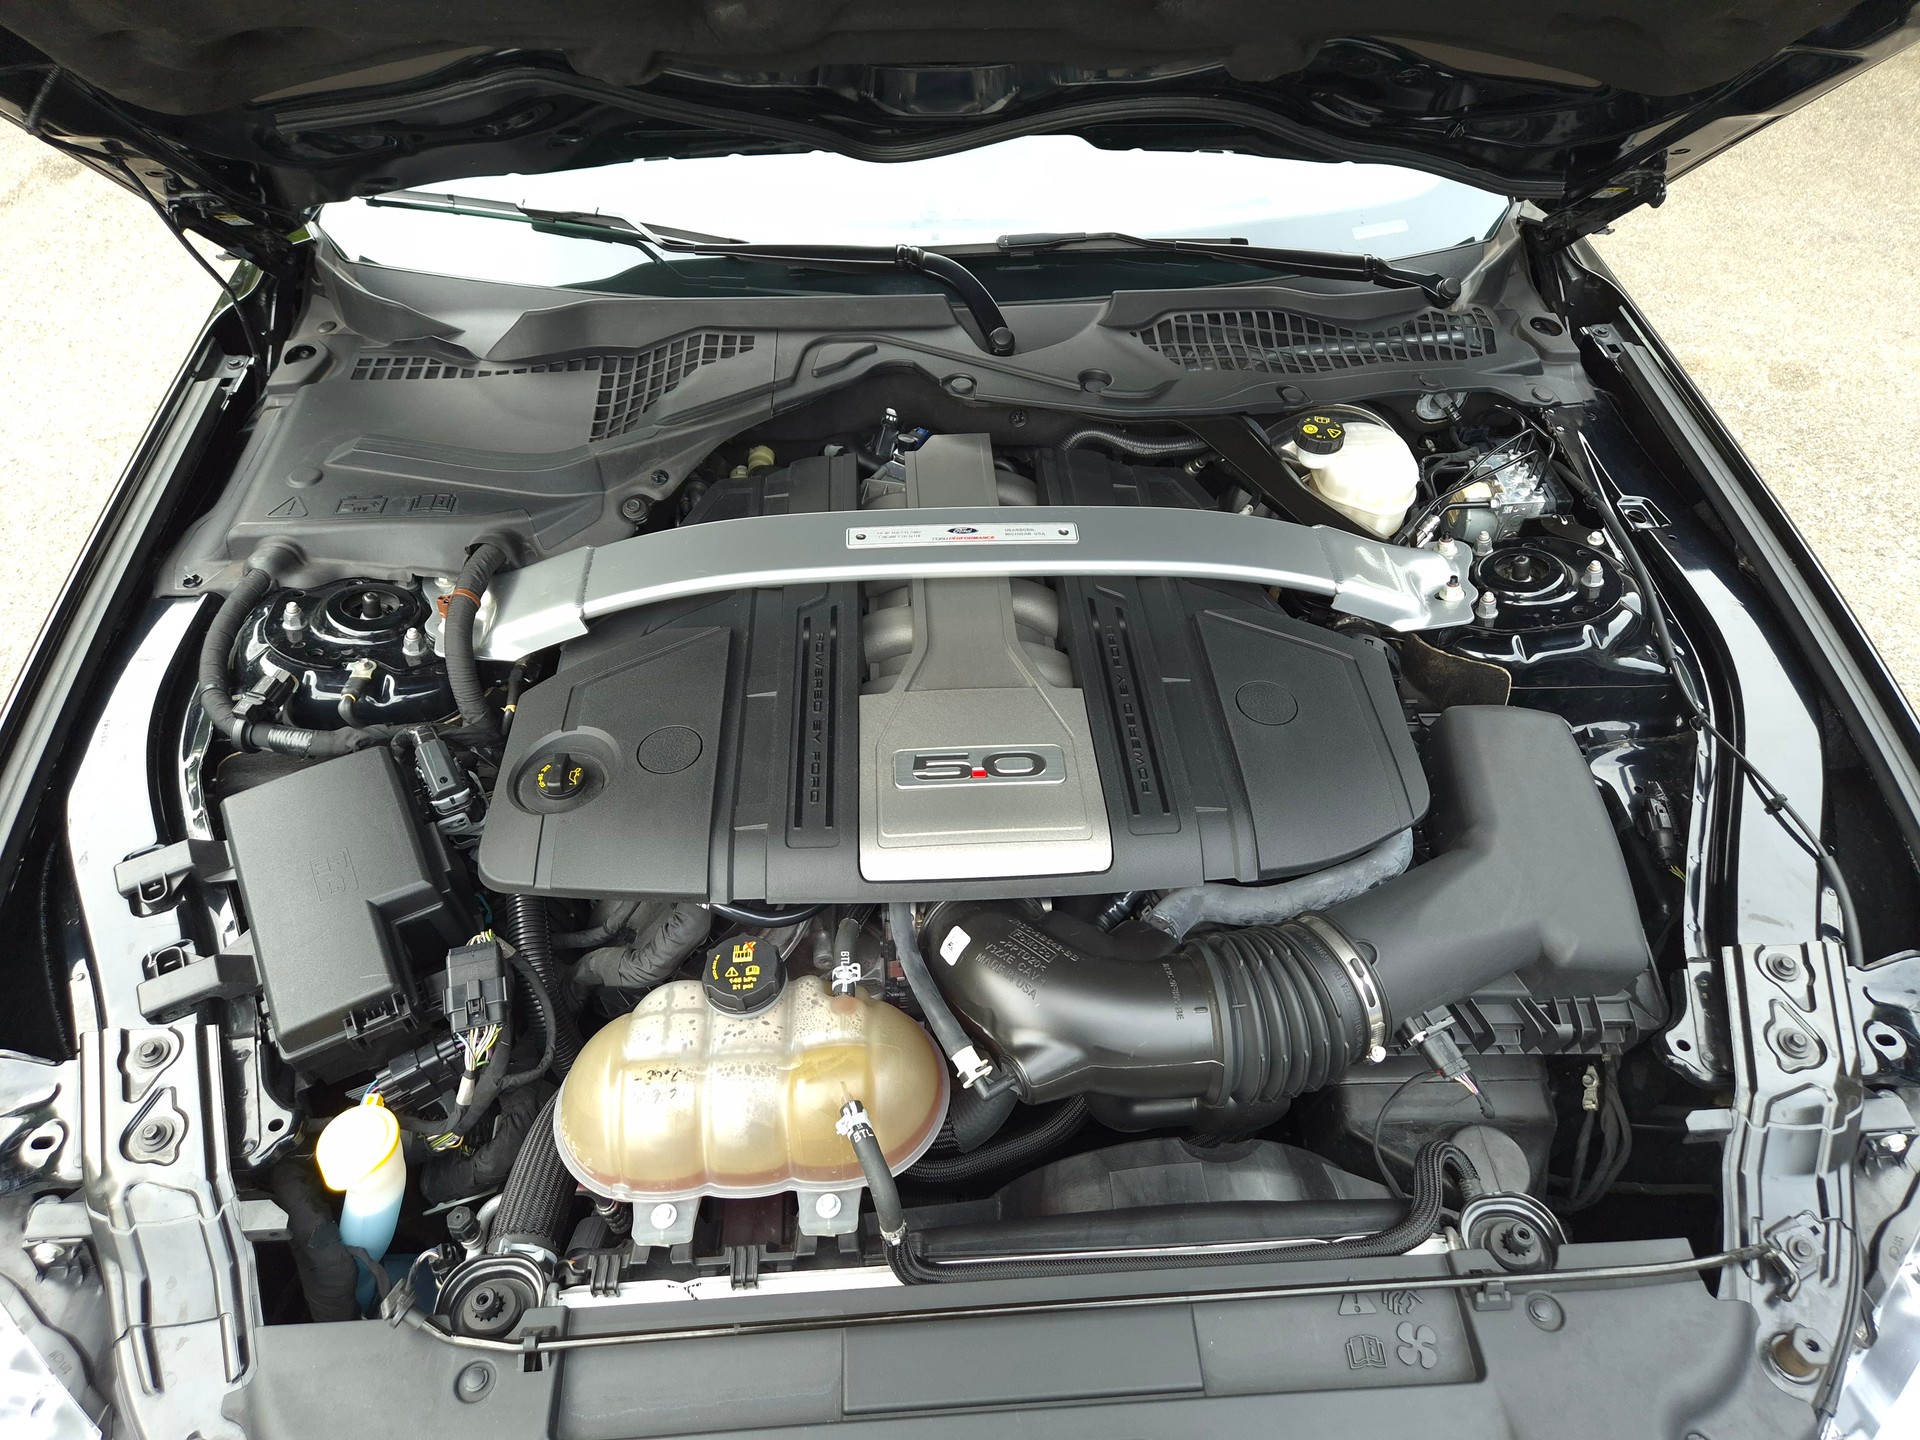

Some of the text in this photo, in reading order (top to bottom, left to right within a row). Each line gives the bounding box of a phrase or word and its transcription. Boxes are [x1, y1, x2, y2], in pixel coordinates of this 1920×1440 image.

[1115, 674, 1130, 697] BY
[810, 632, 825, 805] POWERED BY FORD
[1122, 701, 1152, 795] POWERED
[912, 751, 1048, 781] 5.0
[1011, 931, 1052, 959] FoMoCo
[975, 952, 1004, 975] MADE
[1015, 976, 1038, 1000] USA
[1018, 961, 1039, 981] CAV
[853, 1128, 875, 1143] BTL
